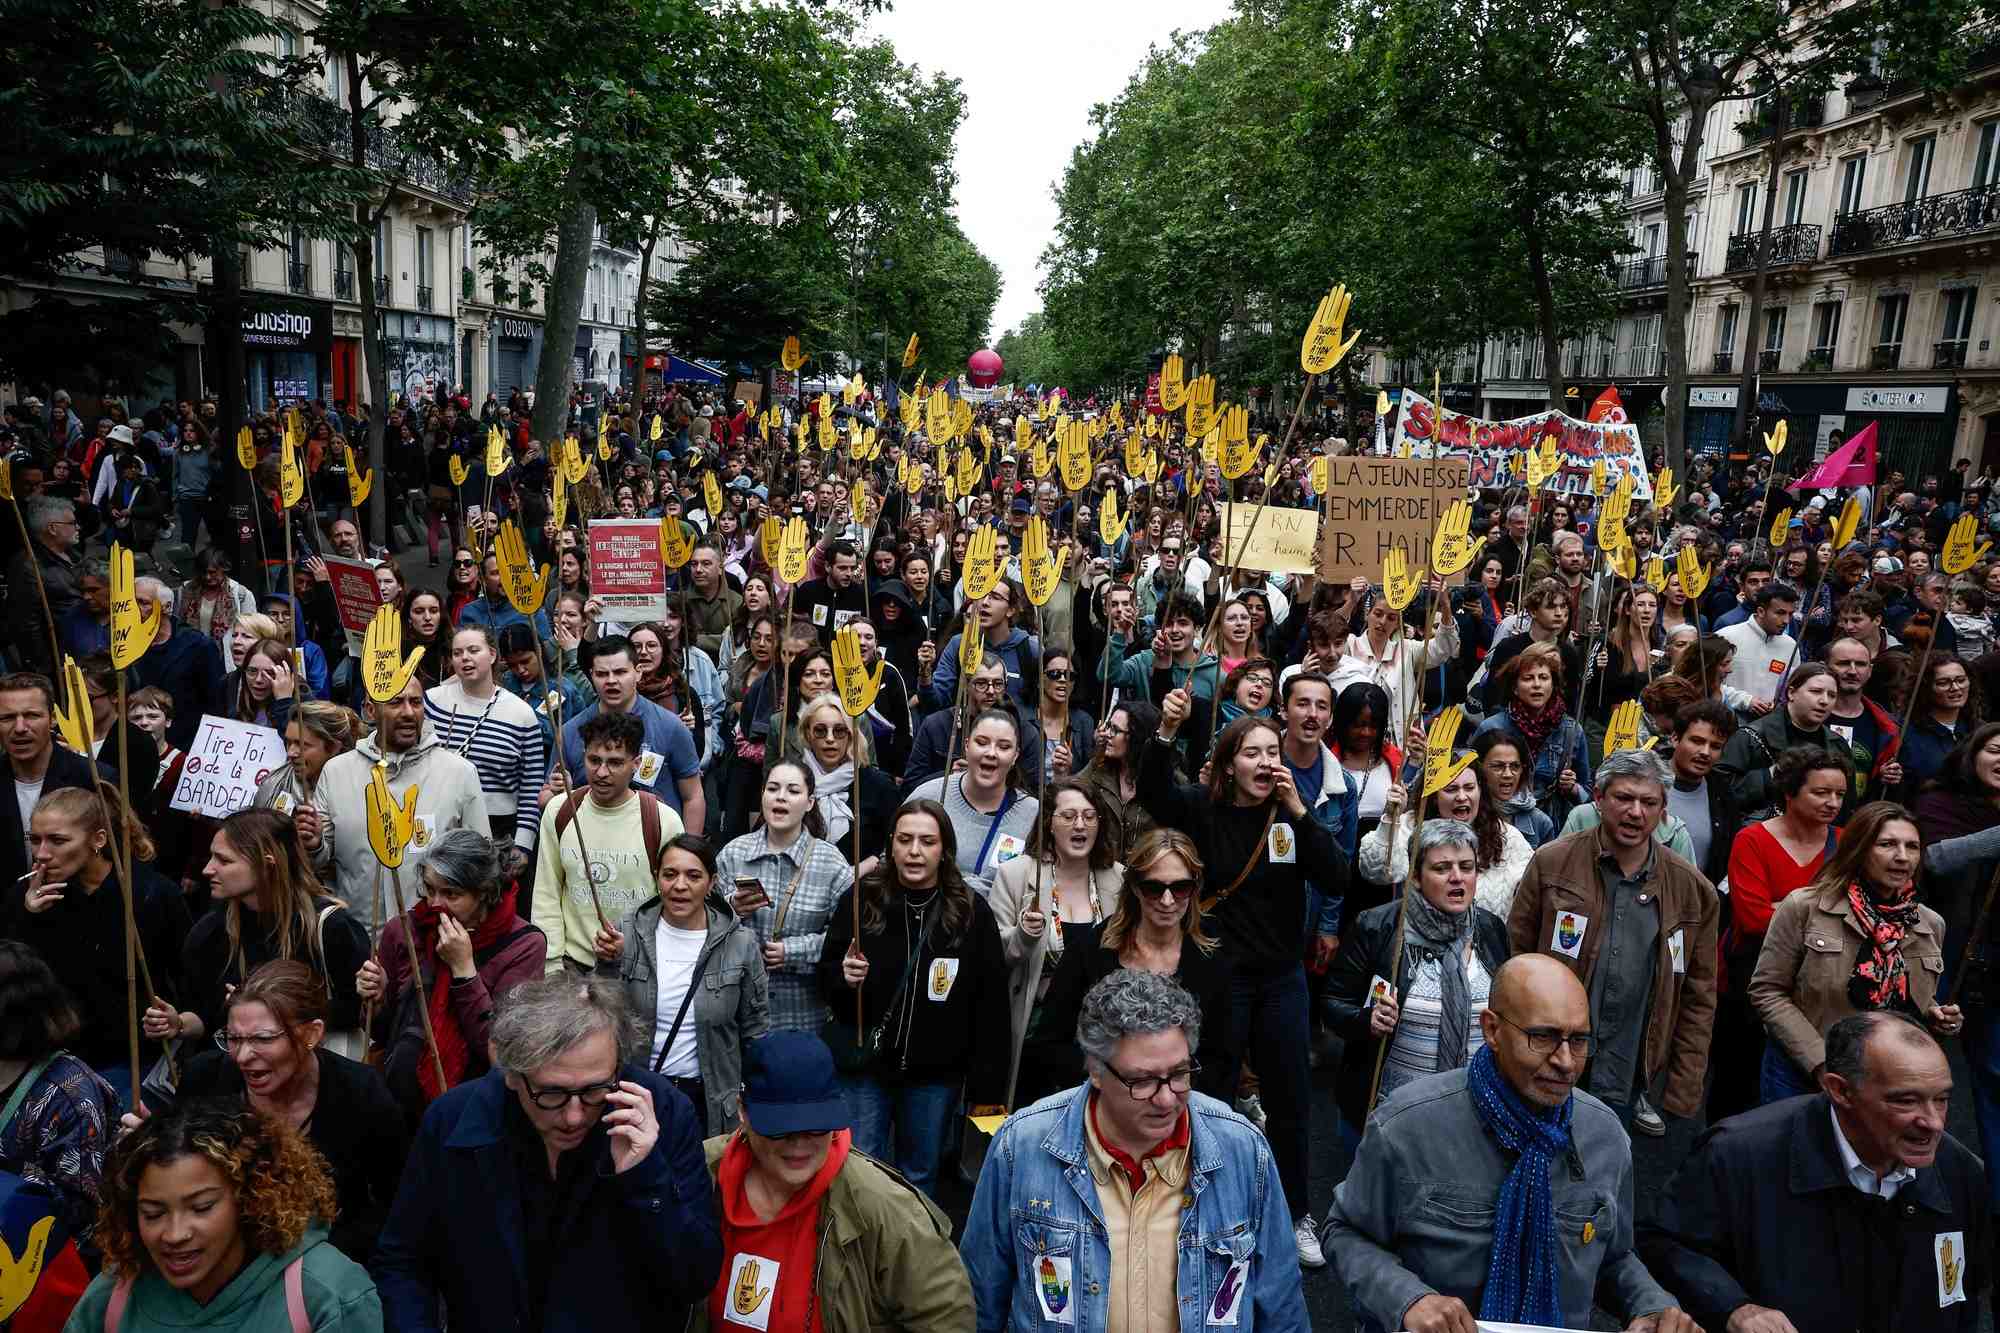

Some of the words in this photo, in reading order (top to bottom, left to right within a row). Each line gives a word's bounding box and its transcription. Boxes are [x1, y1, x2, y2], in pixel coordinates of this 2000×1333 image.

[505, 319, 535, 337] ODEON
[1333, 462, 1362, 486] LA
[1368, 465, 1468, 489] JEUNESSE
[1331, 496, 1429, 520] EMMERDE
[1334, 532, 1363, 566] R.
[204, 723, 234, 755] Tire
[243, 731, 266, 762] Toi
[204, 754, 220, 774] de
